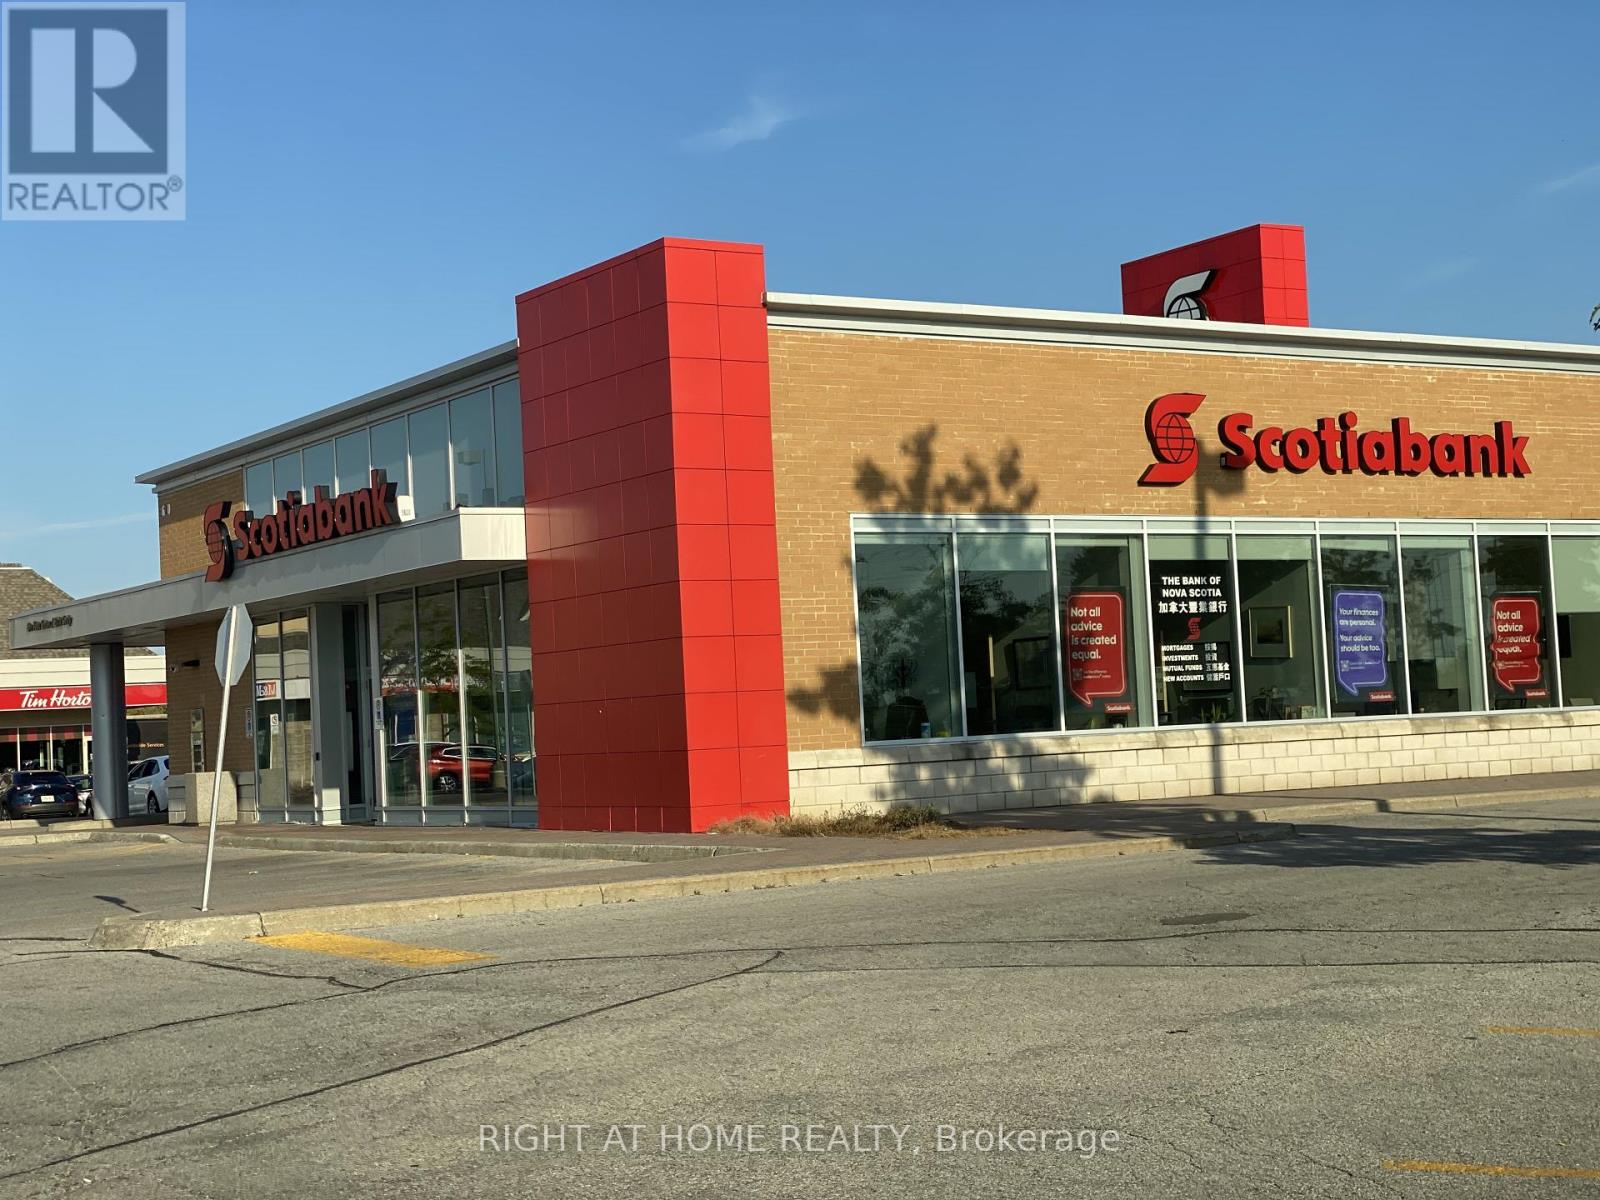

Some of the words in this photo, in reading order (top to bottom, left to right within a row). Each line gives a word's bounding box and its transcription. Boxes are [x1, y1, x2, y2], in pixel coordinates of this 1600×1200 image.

[1217, 411, 1532, 478] Scotiabank
[233, 468, 398, 561] Scotiabank
[1161, 576, 1181, 586] THE
[1181, 576, 1207, 586] BANK
[1209, 576, 1221, 585] OF
[1162, 588, 1187, 597] NOVA
[1188, 588, 1222, 597] SCOTIA
[1070, 607, 1087, 617] Not
[1088, 606, 1101, 617] all
[1339, 607, 1352, 616] Your
[1353, 607, 1379, 616] finances
[1496, 611, 1510, 620] Not
[1510, 610, 1521, 619] all
[1071, 621, 1103, 632] advice
[1349, 618, 1376, 627] personal.
[1497, 622, 1524, 632] advice
[1071, 635, 1079, 645] is
[1081, 634, 1117, 645] created
[1339, 634, 1352, 642] Your
[1353, 633, 1373, 642] advice
[1340, 643, 1360, 652] should
[1361, 644, 1369, 652] be
[1369, 643, 1381, 652] too.
[1072, 648, 1101, 662] equal.
[1162, 654, 1199, 662] INVESTMENTS
[19, 690, 48, 708] Tim
[49, 688, 92, 707] Horto
